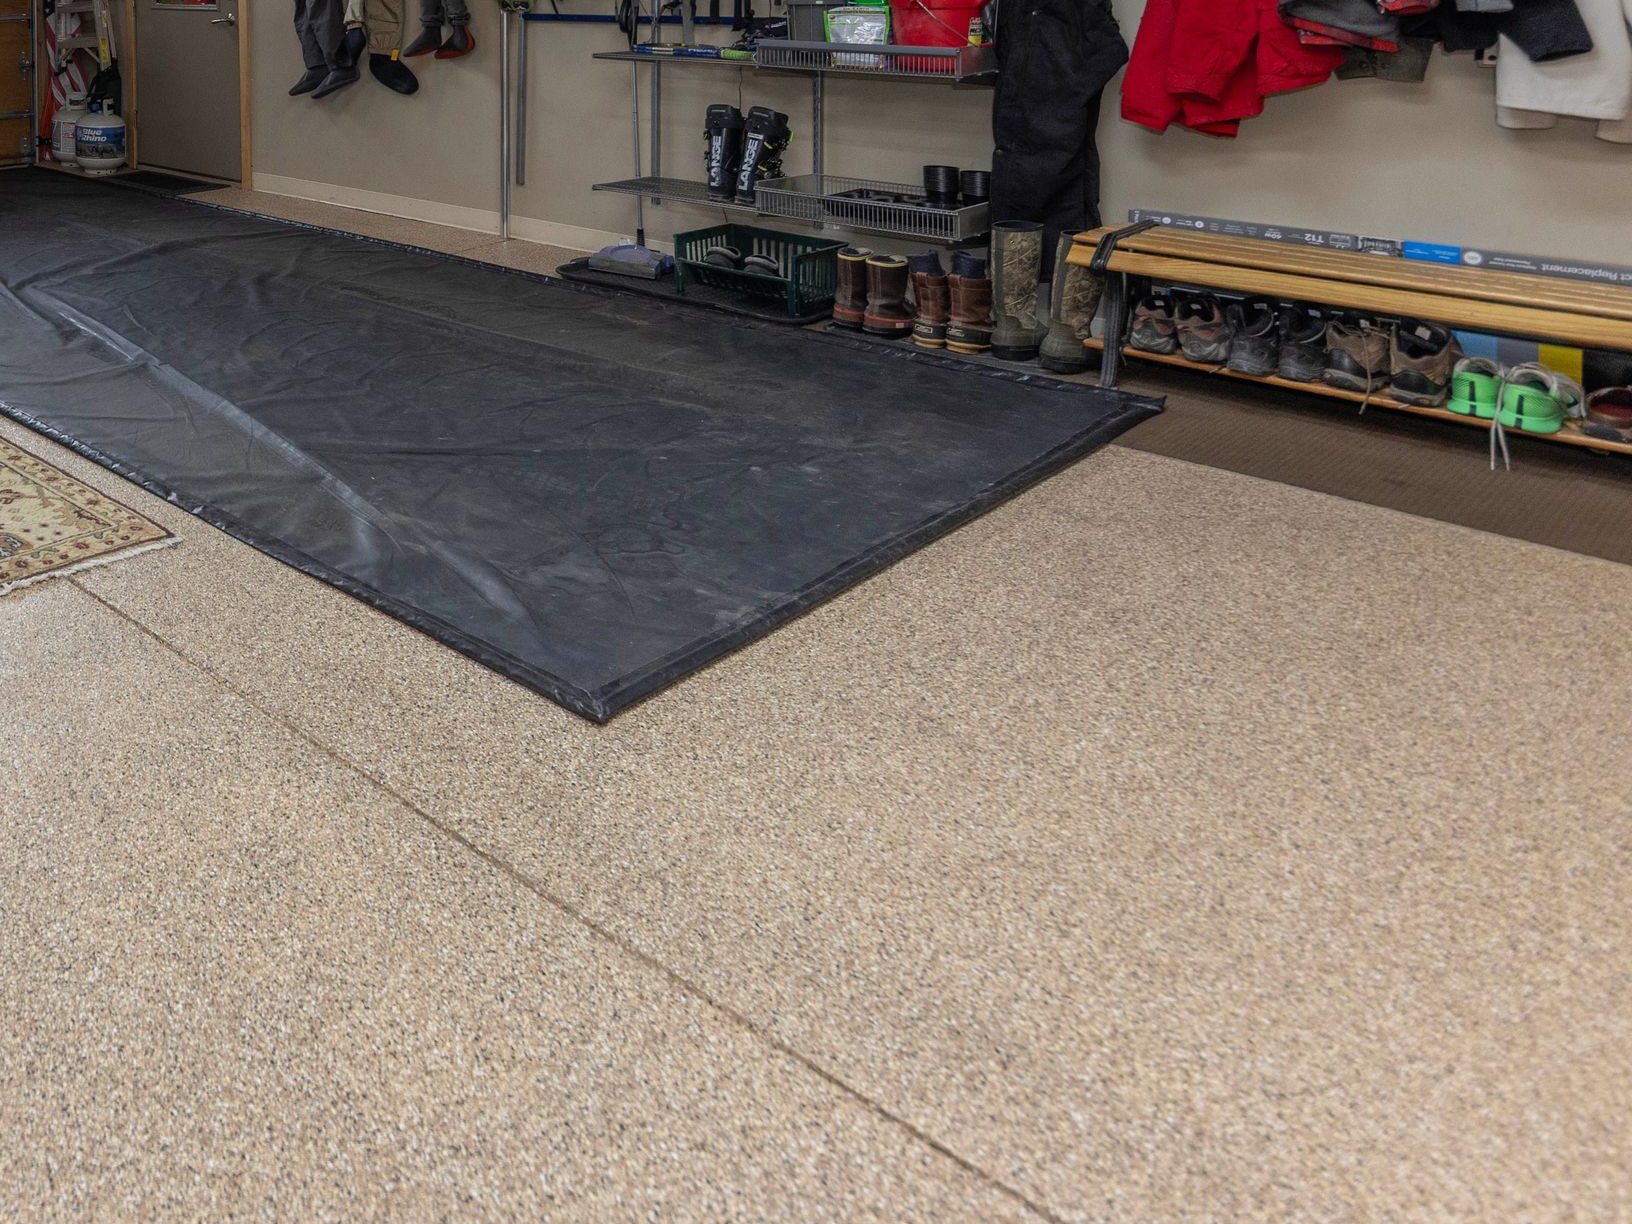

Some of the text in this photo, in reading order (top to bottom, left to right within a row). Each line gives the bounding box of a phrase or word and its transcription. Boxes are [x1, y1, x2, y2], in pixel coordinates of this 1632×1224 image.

[710, 136, 721, 187] LANGE
[738, 139, 758, 191] LANGE
[1304, 233, 1324, 243] T12
[1540, 262, 1618, 280] Replacement
